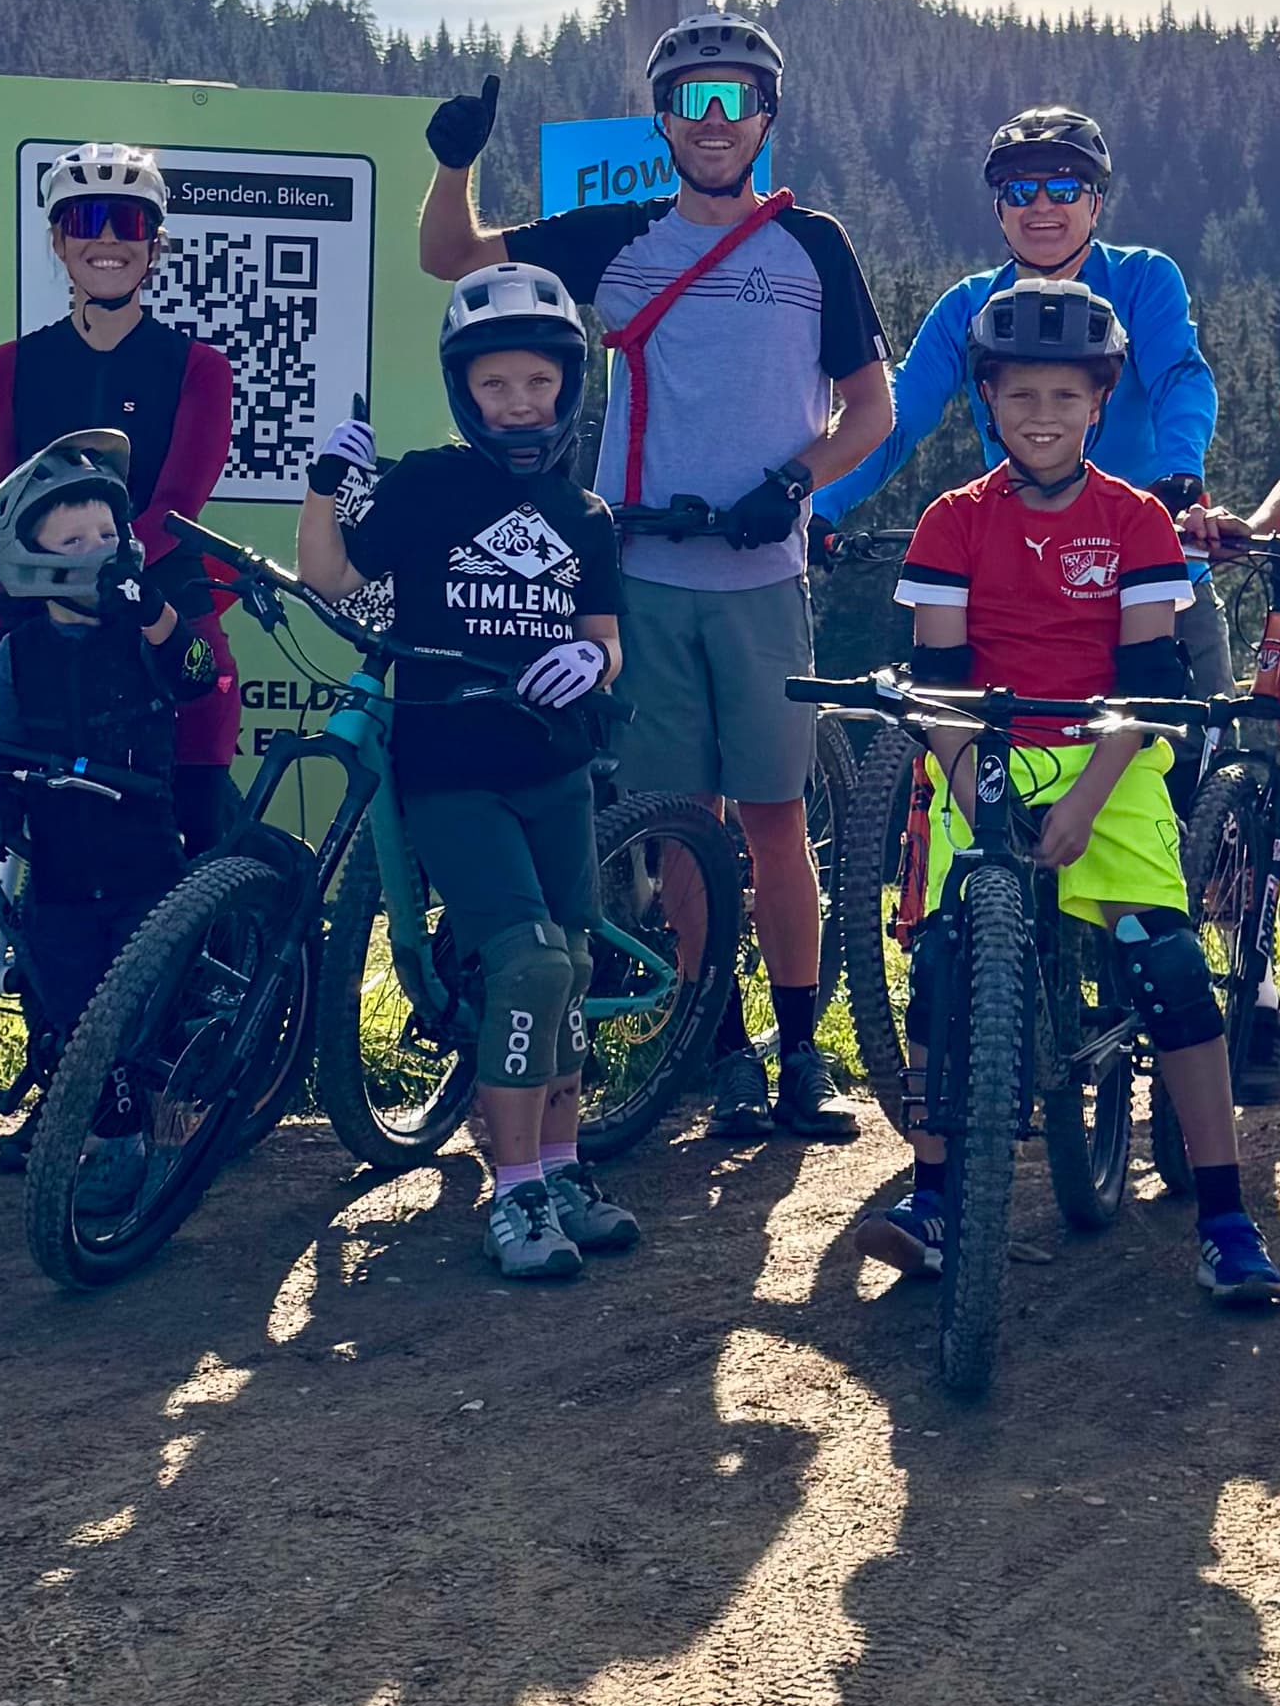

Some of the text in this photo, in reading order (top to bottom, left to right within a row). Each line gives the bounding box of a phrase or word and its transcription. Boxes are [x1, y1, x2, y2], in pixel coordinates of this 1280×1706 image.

[182, 182, 272, 204] Spenden.
[278, 187, 335, 207] Biken.
[465, 618, 573, 641] TRIATHLON
[505, 1009, 533, 1075] POC
